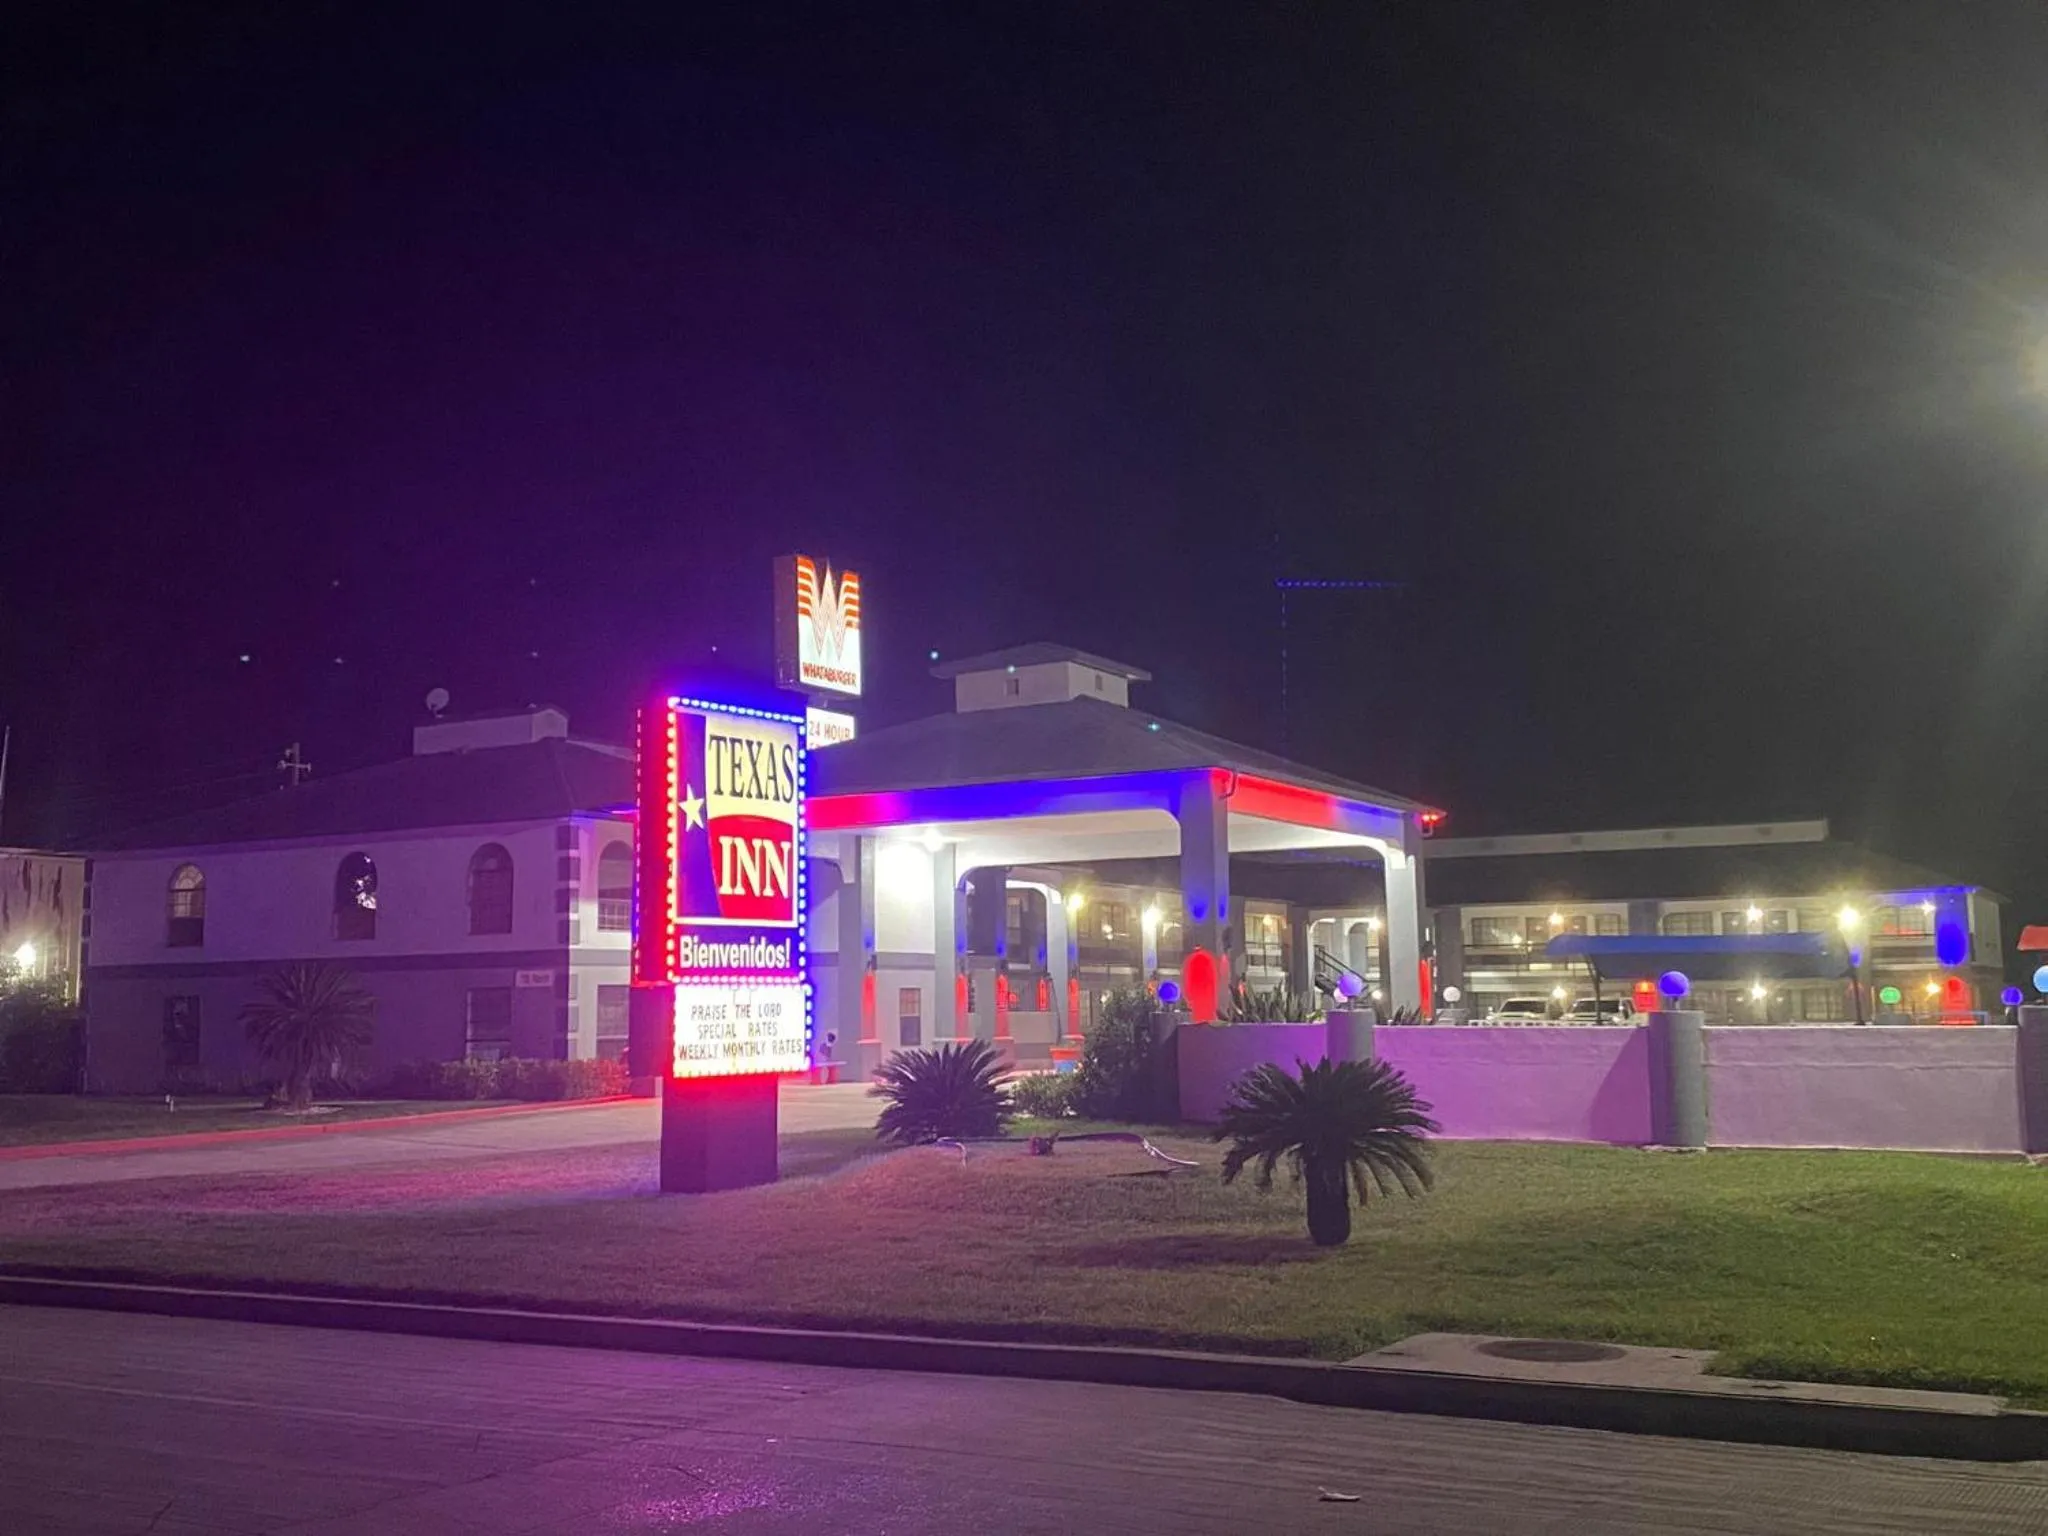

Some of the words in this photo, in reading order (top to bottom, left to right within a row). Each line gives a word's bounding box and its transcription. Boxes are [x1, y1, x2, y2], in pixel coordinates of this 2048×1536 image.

[802, 661, 857, 688] WHATABURGER
[809, 720, 820, 736] 24
[824, 723, 850, 740] HOUR
[709, 734, 795, 803] TEXAS
[718, 836, 792, 899] INN
[679, 934, 792, 969] Bienvenidos!
[690, 1004, 727, 1021] PRAISE
[735, 1003, 751, 1019] THE
[758, 1002, 782, 1018] LORD
[697, 1023, 737, 1040] SPECIAL
[748, 1021, 778, 1037] RATES
[679, 1043, 720, 1060] WEEKLY
[723, 1040, 766, 1058] MONTHLY
[772, 1038, 802, 1055] RATES
